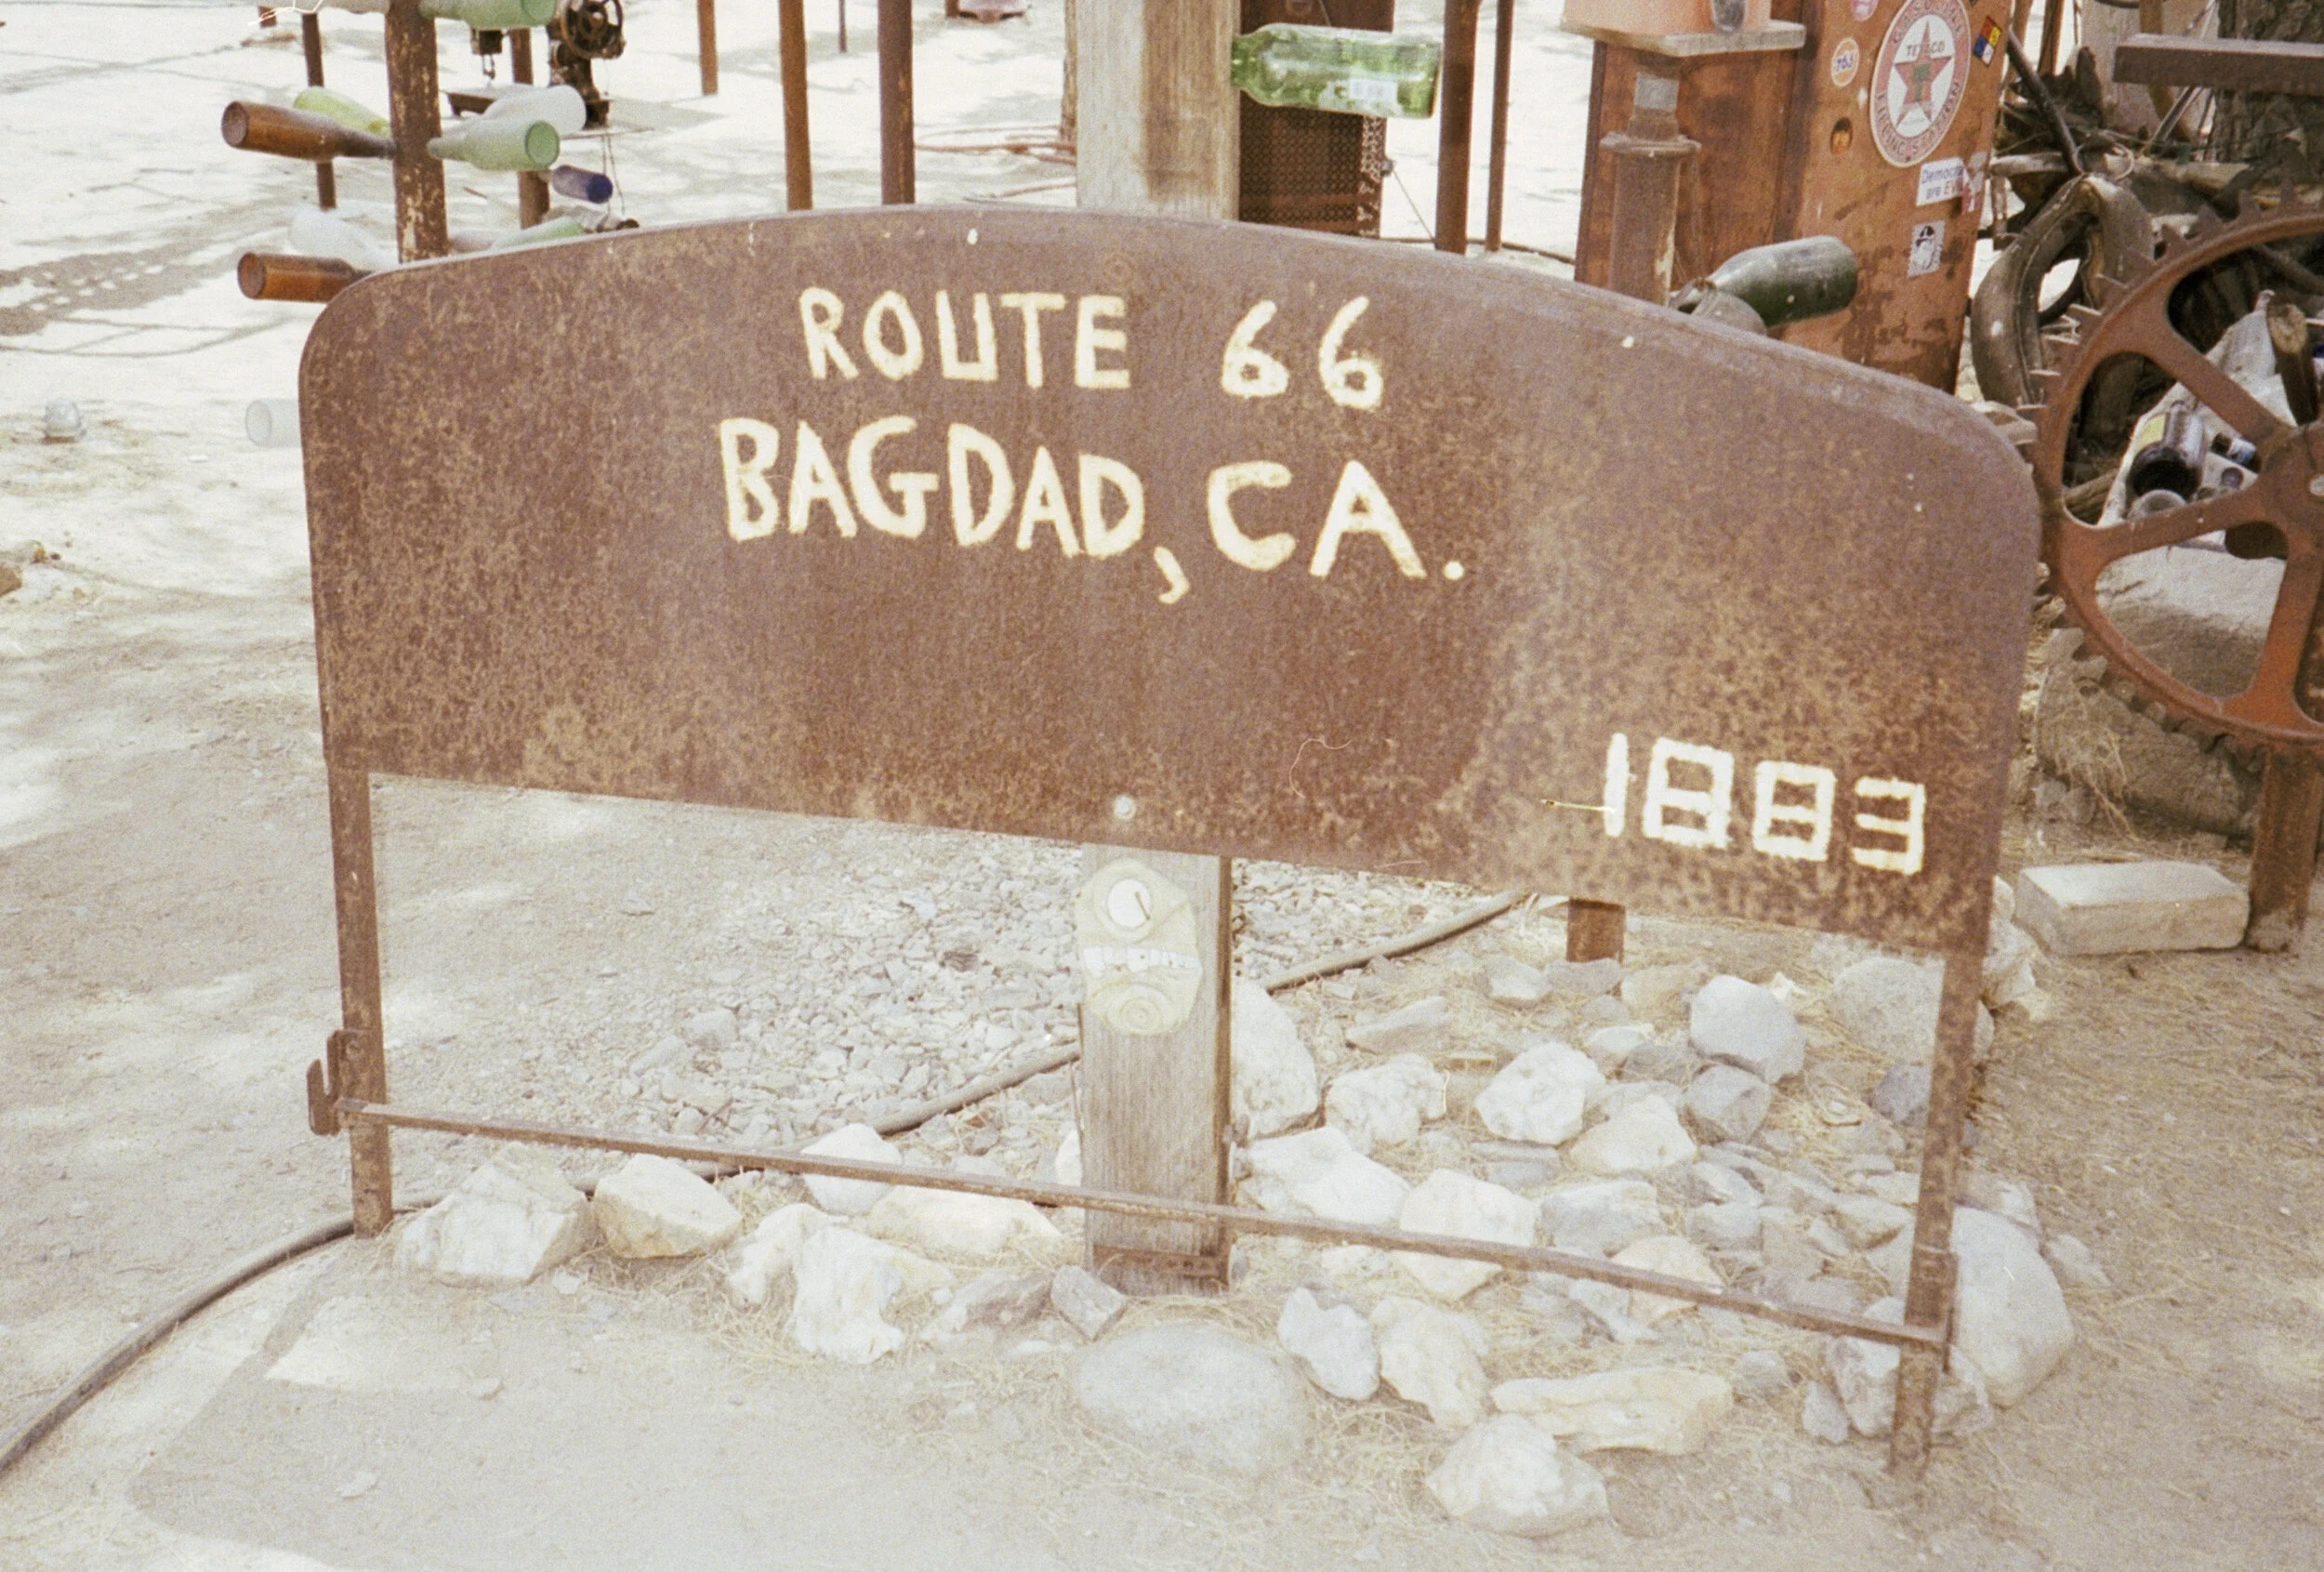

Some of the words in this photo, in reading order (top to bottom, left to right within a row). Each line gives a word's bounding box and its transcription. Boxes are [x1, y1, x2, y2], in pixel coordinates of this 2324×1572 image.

[1905, 39, 1946, 58] TEXACO
[799, 286, 1131, 389] ROUTE
[1221, 296, 1384, 411] 66
[1208, 459, 1465, 580] CA.
[1603, 732, 1927, 876] 1883
